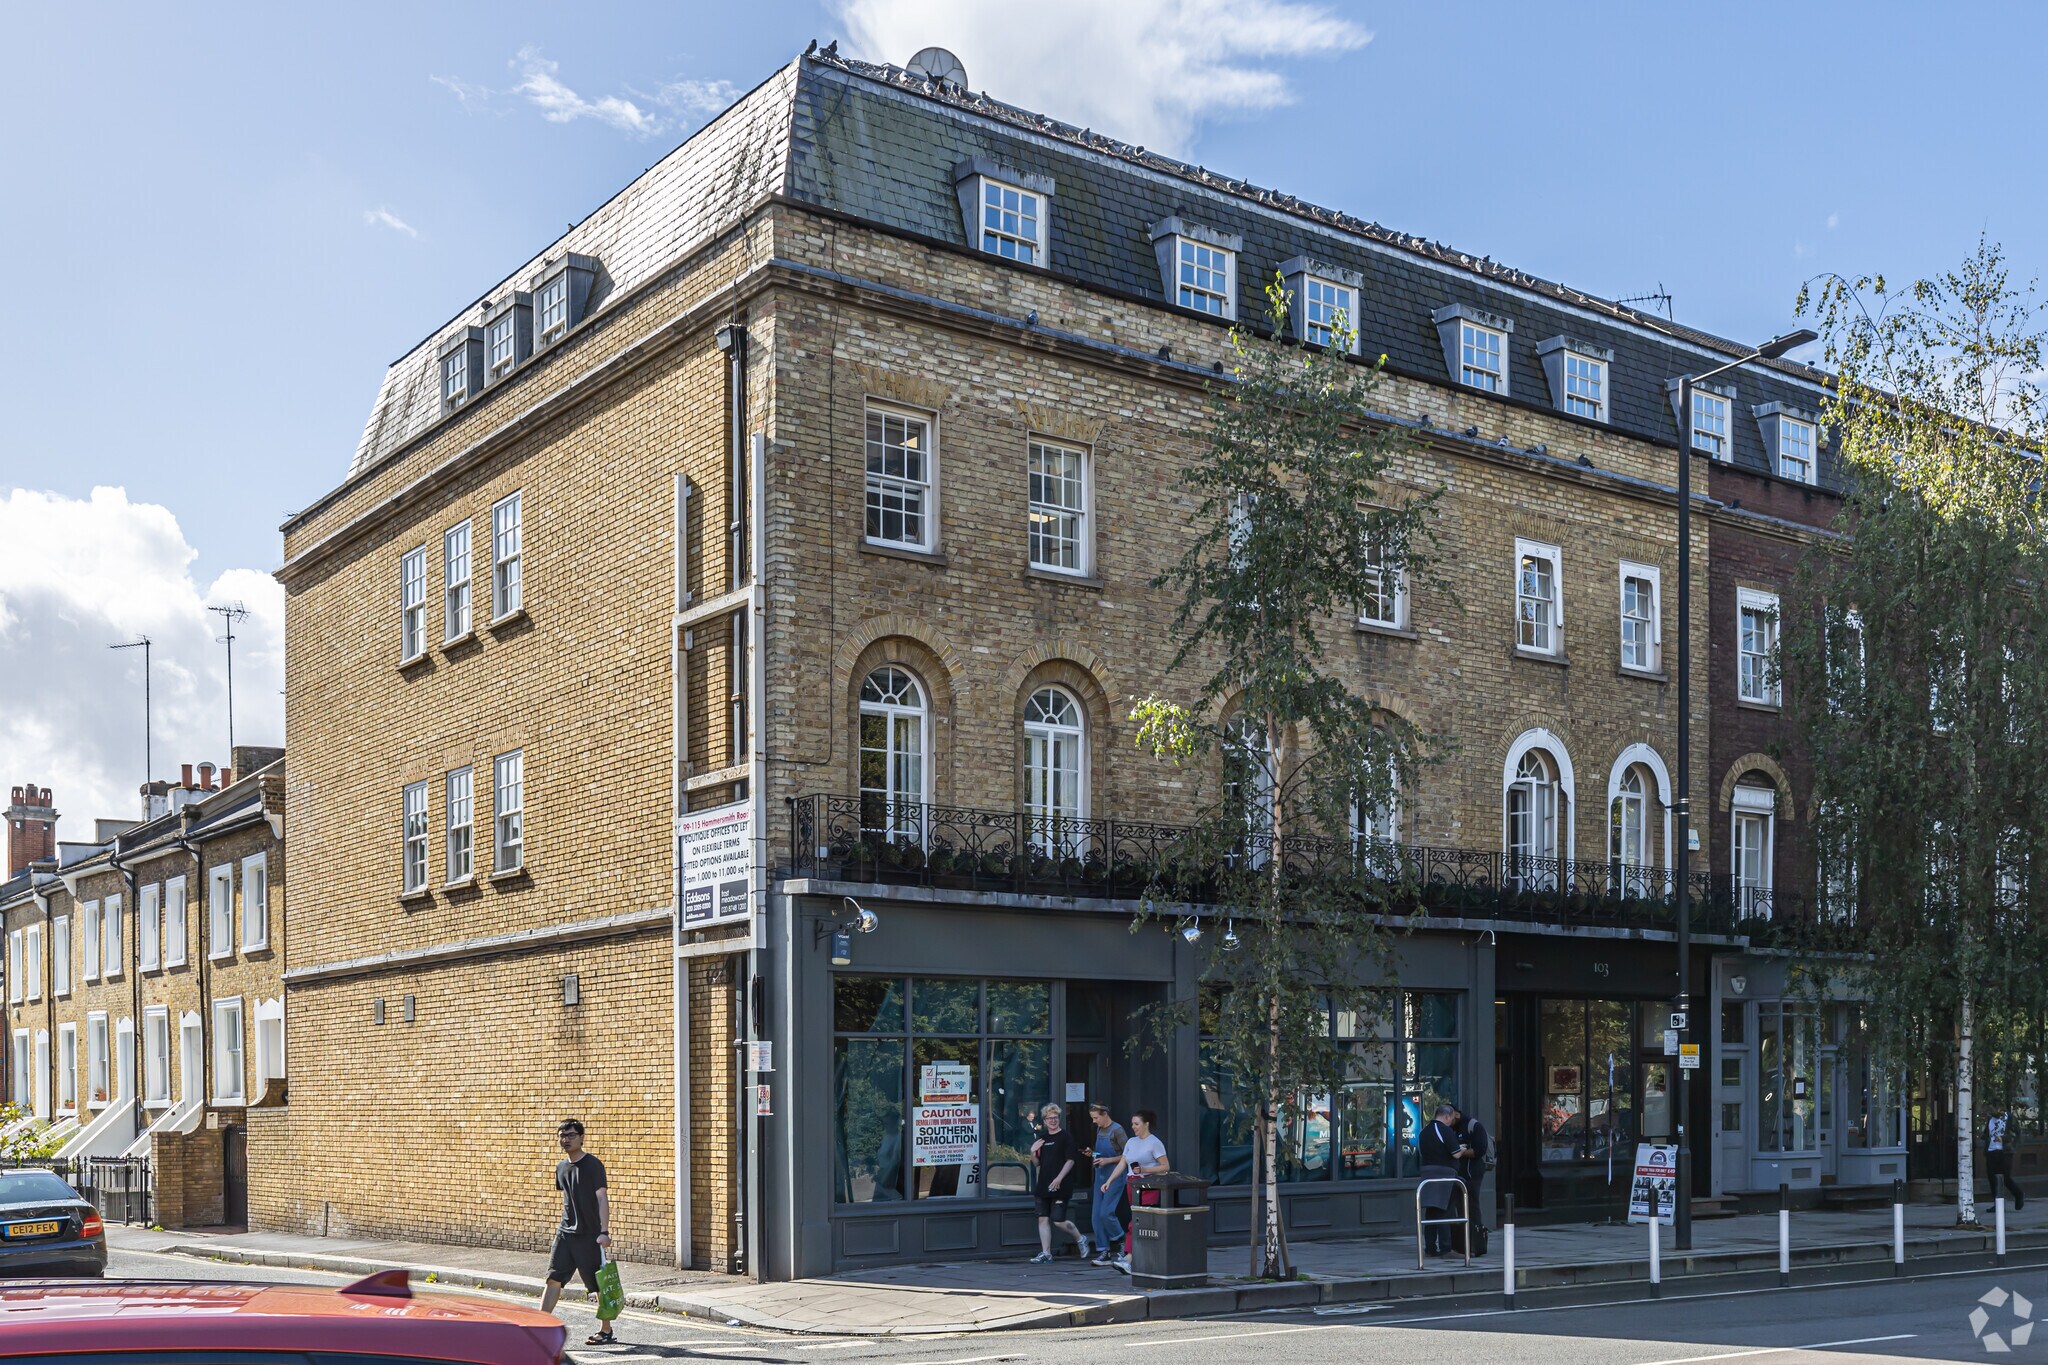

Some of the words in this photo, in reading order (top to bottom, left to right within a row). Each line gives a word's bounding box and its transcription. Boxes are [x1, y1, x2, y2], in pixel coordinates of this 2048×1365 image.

[683, 821, 700, 832] 99-115
[702, 813, 736, 828] Hammersmith
[684, 829, 710, 844] BOUTIQUE
[710, 826, 730, 838] OFFICES
[731, 823, 739, 833] TO
[740, 821, 748, 832] LET
[692, 846, 701, 856] ON
[701, 841, 723, 854] FLEXIBLE
[723, 837, 740, 849] TERMS
[699, 855, 722, 868] OPTIONS
[722, 849, 749, 863] AVAILABLE
[712, 870, 718, 879] to
[718, 866, 737, 878] 11,000
[737, 866, 745, 876] sq
[686, 891, 711, 905] Eddisons
[1594, 962, 1609, 977] 103
[922, 1108, 971, 1119] CAUTION
[919, 1125, 974, 1136] SOUTHERN
[915, 1134, 978, 1146] DEMOLITION
[12, 1225, 34, 1234] CE12
[36, 1223, 55, 1232] FEK
[1138, 1228, 1158, 1238] LITTER
